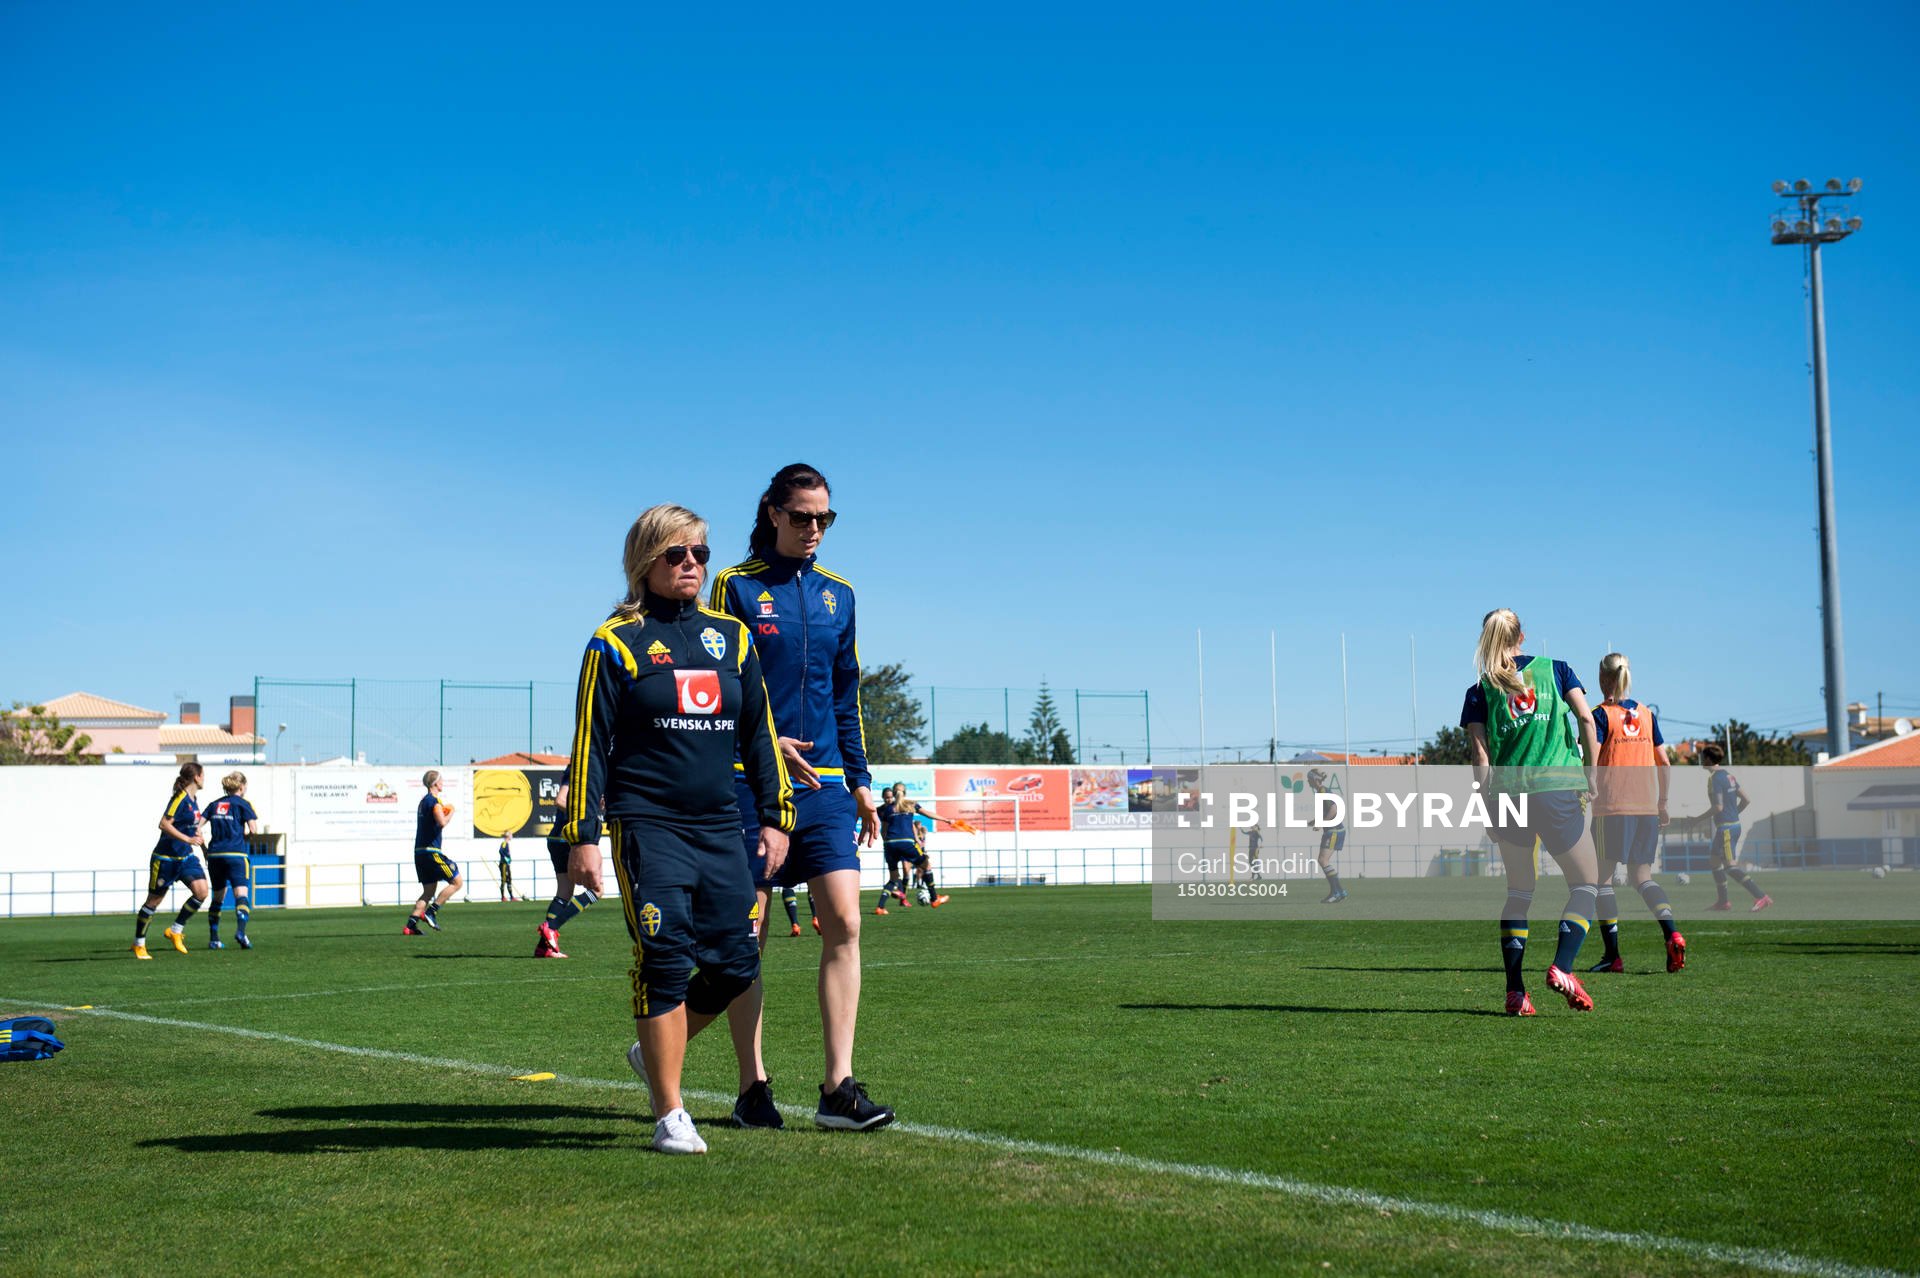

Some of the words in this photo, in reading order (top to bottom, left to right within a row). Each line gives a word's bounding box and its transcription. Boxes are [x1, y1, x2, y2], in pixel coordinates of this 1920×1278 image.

[757, 623, 780, 636] ICA
[650, 653, 674, 665] ICA
[653, 717, 712, 731] SVENSKA
[964, 778, 997, 792] Auto
[1087, 814, 1136, 825] QUINTA
